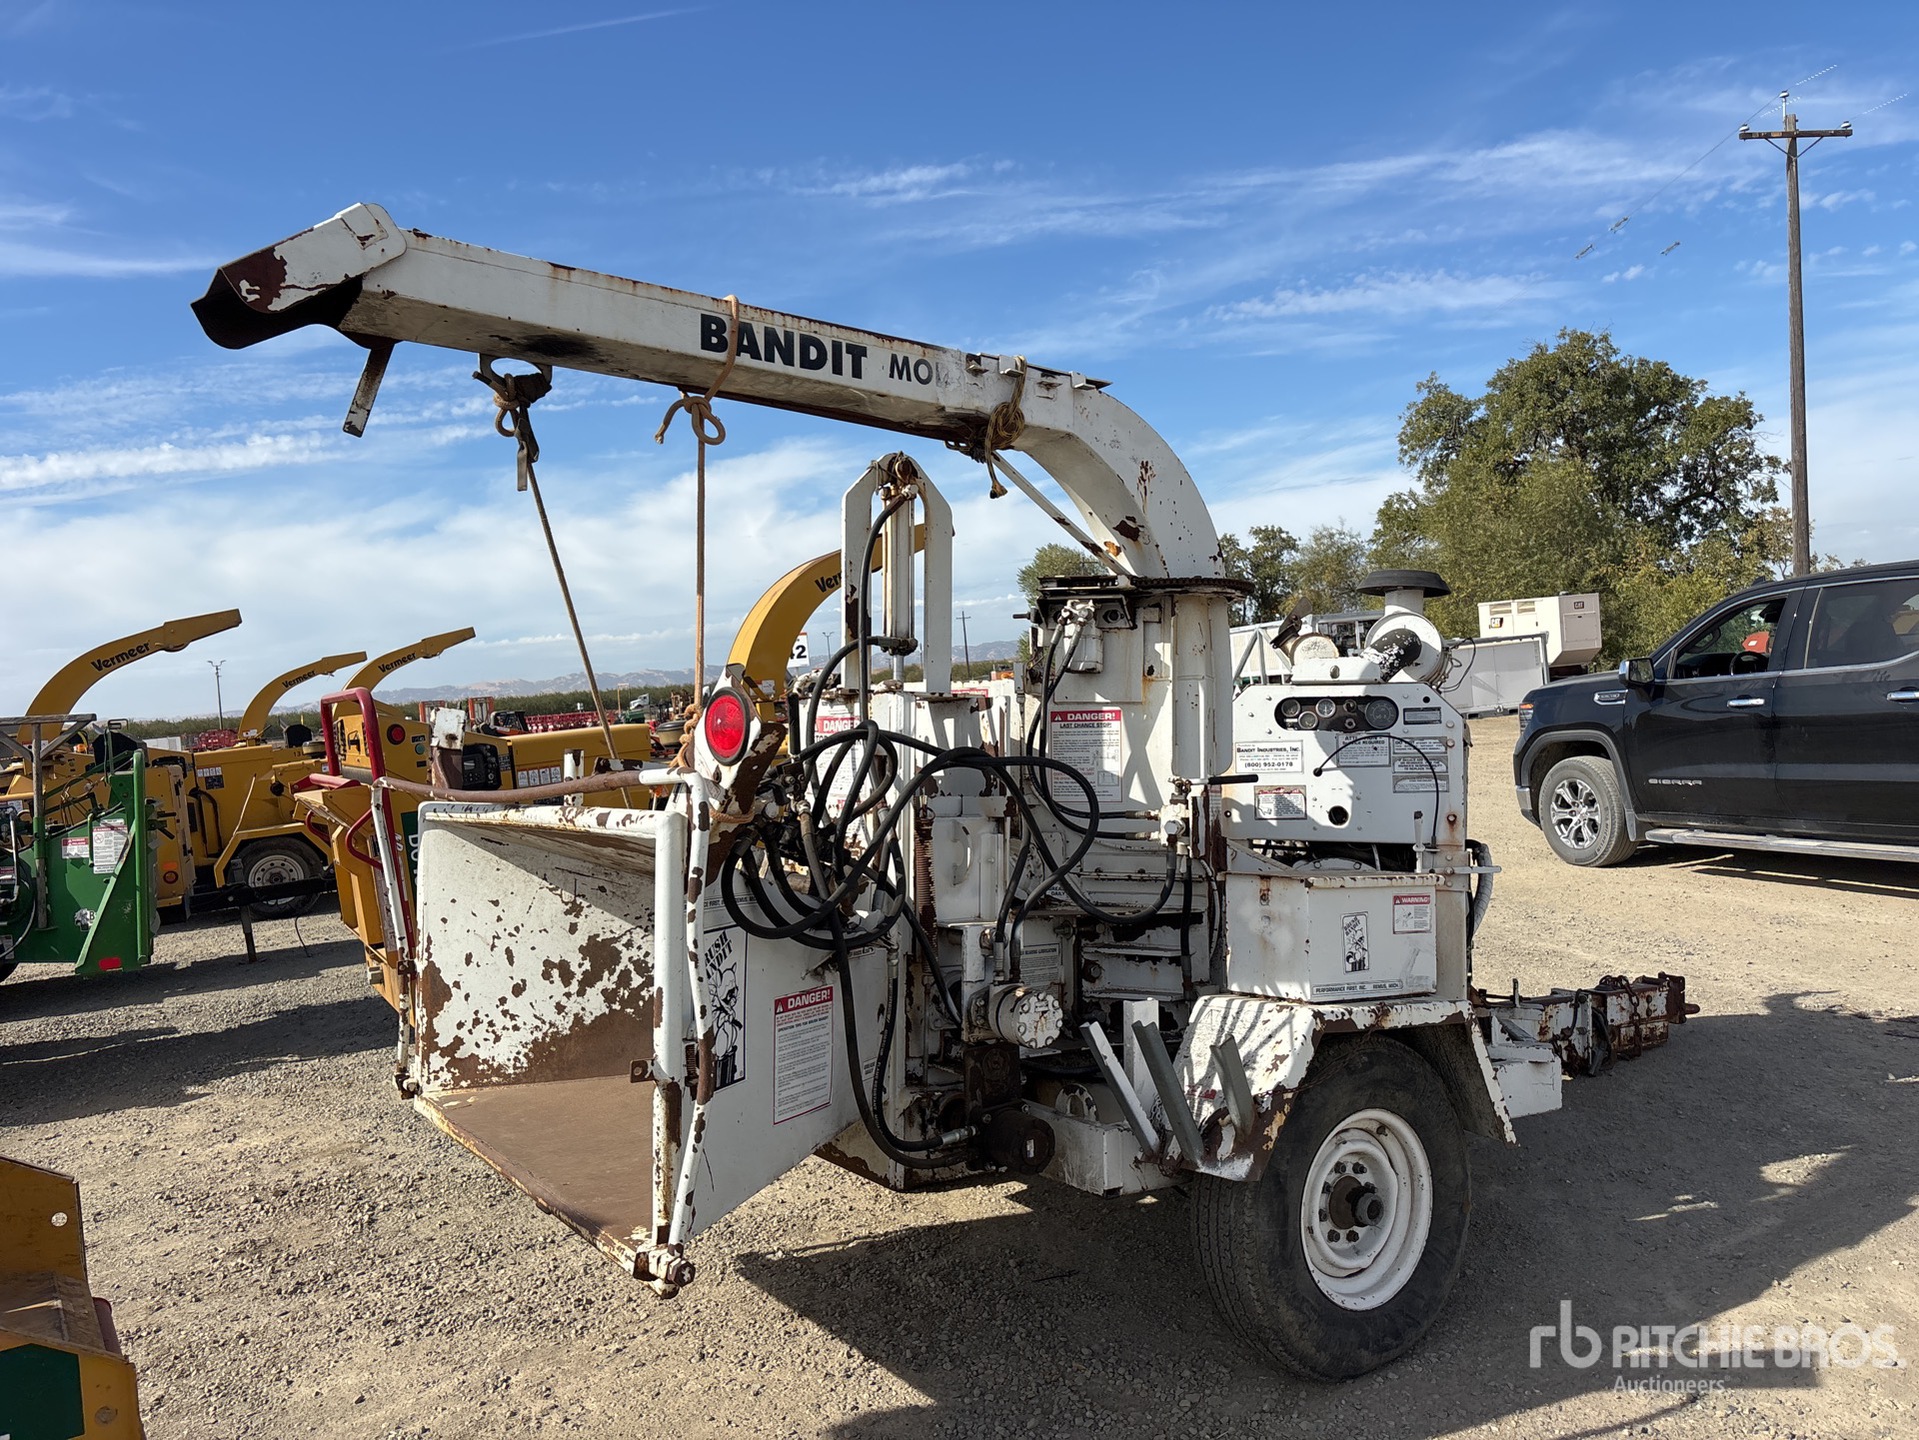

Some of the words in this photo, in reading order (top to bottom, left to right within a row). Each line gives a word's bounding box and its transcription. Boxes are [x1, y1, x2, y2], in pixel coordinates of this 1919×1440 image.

[700, 313, 868, 380] BANDIT
[814, 571, 842, 593] Ver
[90, 642, 150, 672] Vermeer
[378, 652, 417, 674] Vermeer
[790, 644, 807, 660] 2
[282, 669, 316, 689] Vermeer
[1067, 712, 1116, 720] DANGER!
[704, 930, 728, 967] RUSH
[787, 989, 830, 1009] DANGER!
